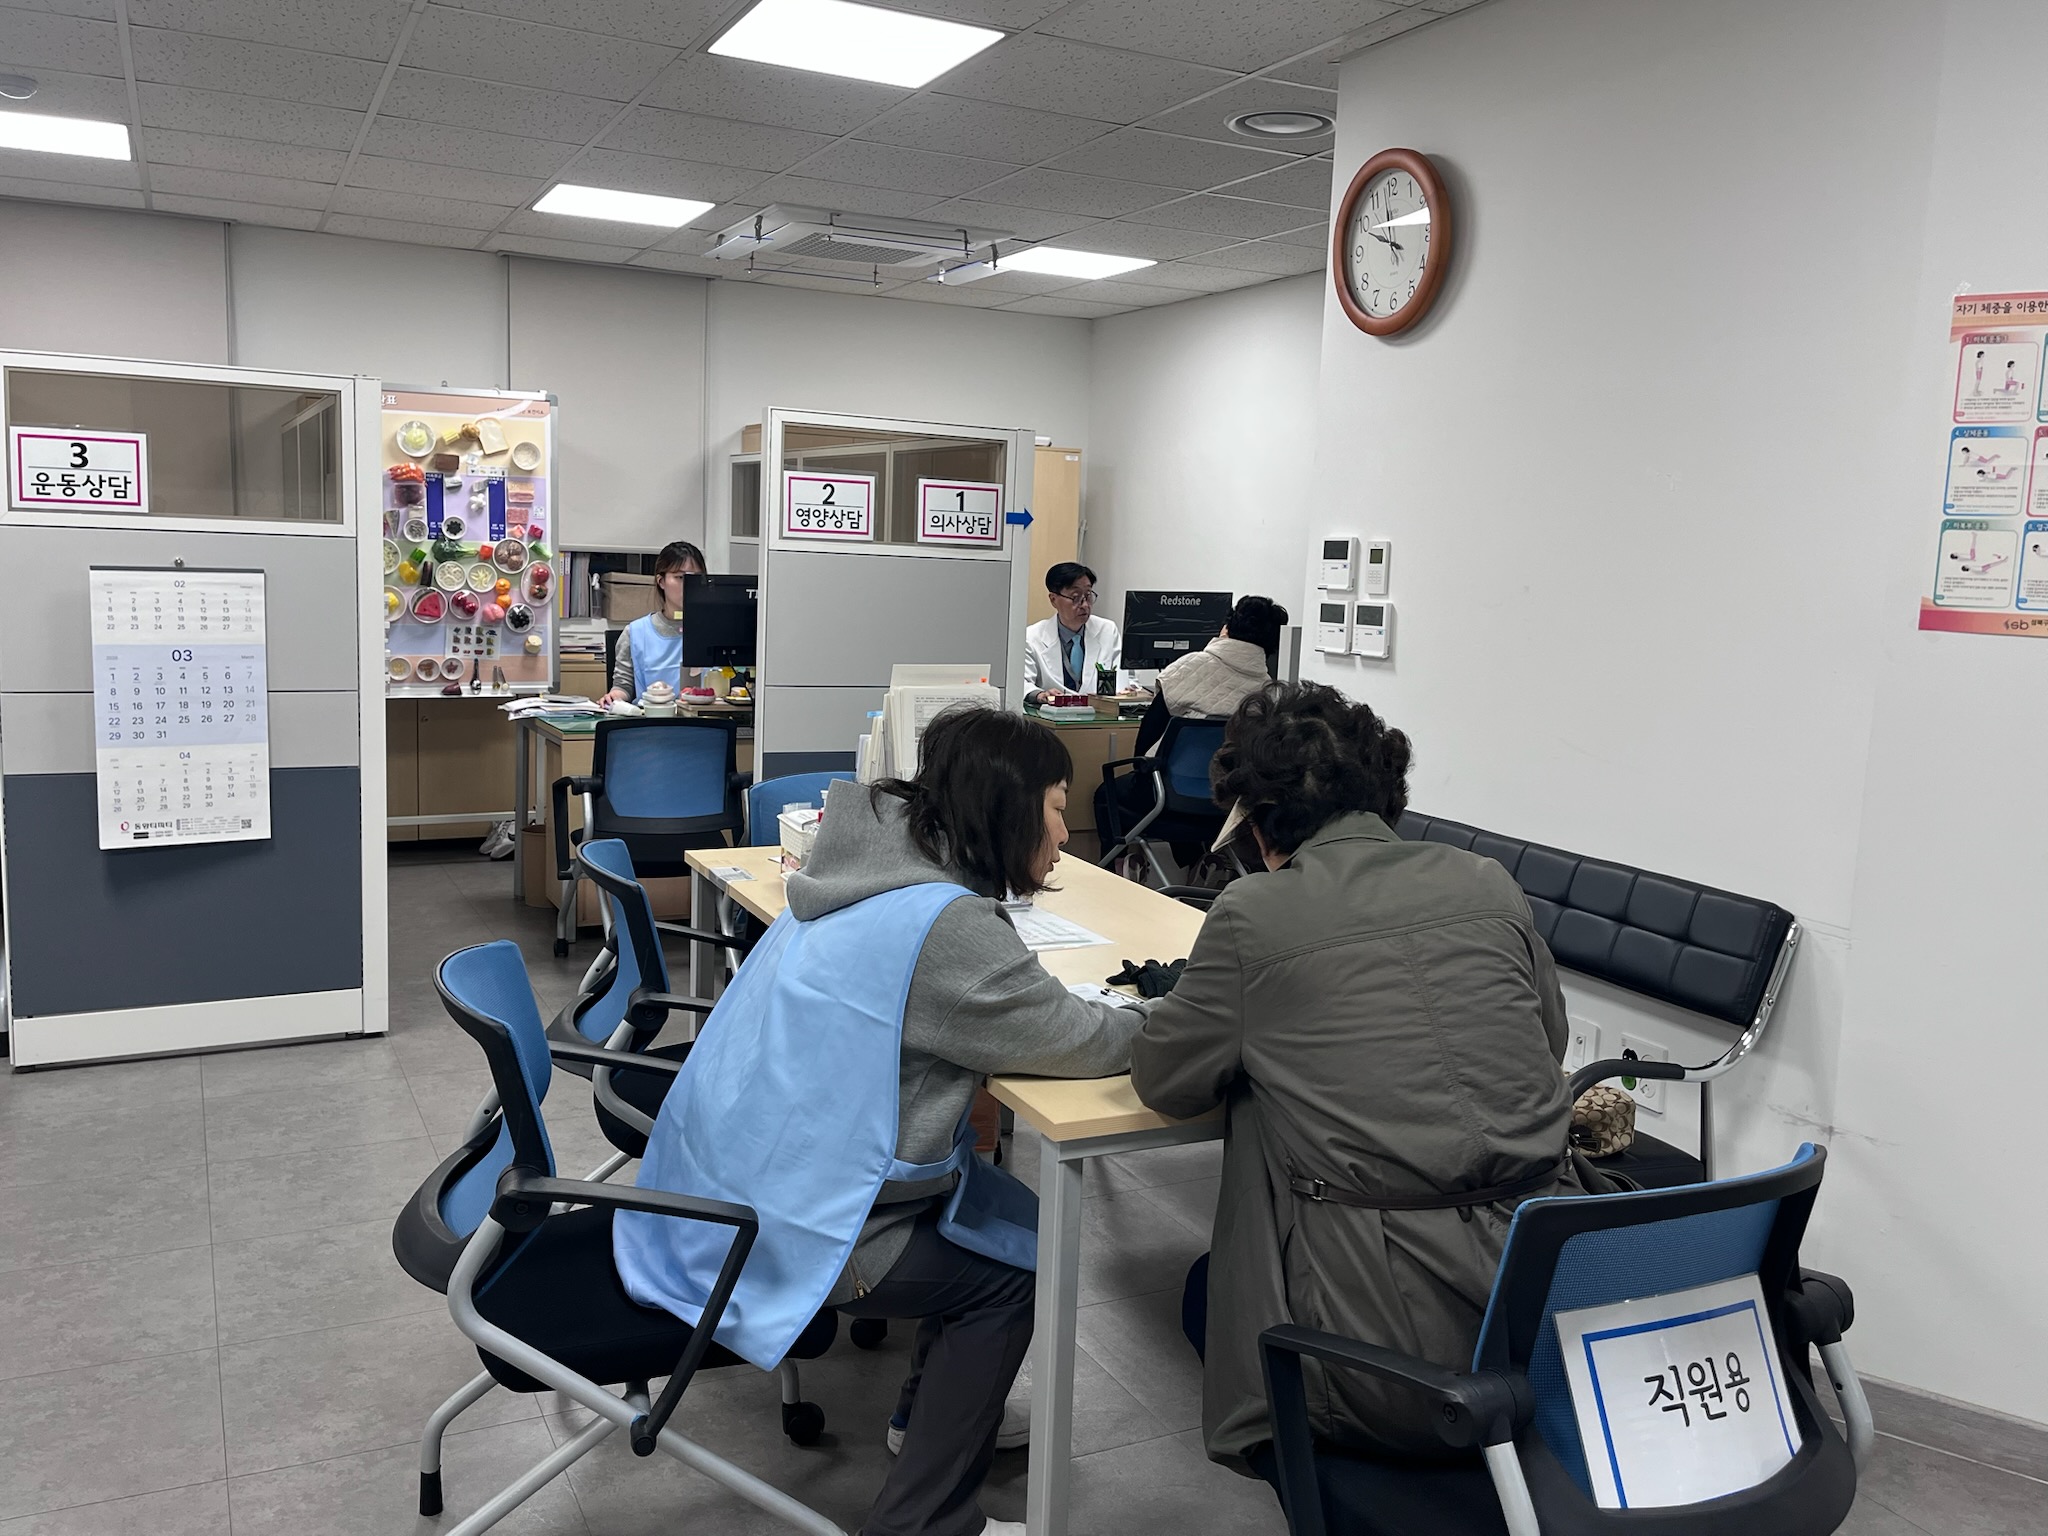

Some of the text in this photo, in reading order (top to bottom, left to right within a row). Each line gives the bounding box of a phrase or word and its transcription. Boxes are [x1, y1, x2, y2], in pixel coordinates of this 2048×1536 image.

[1386, 177, 1398, 198] 12
[1407, 179, 1412, 198] 1
[1370, 192, 1380, 211] 11
[1358, 215, 1370, 233] 10
[1355, 245, 1364, 264] 9
[1418, 253, 1425, 272] 4
[1361, 273, 1369, 291] 8
[1407, 280, 1416, 299] 5
[1372, 289, 1380, 307] 7
[1389, 291, 1398, 310] 6
[1956, 303, 1977, 315] 자기
[1980, 301, 2012, 315] 체중을
[70, 443, 89, 468] 3
[31, 472, 132, 499] 운동상담
[822, 483, 836, 505] 2
[956, 491, 965, 512] 1
[795, 508, 863, 530] 영양상담
[930, 514, 992, 536] 의사상담
[174, 580, 185, 588] 02
[746, 589, 758, 599] T
[1160, 594, 1202, 606] Redstone
[172, 649, 193, 662] 03
[111, 671, 253, 681] 1 2 3 4 5 6 7
[110, 685, 255, 696] 8 9 10 11 12 13 14
[109, 700, 255, 711] 15 16 17 18 19 20 21
[108, 714, 256, 726] 22 23 24 25 26 27 28
[109, 730, 167, 740] 29 30 31
[179, 752, 191, 760] 04
[1644, 1351, 1750, 1427] 직원용
